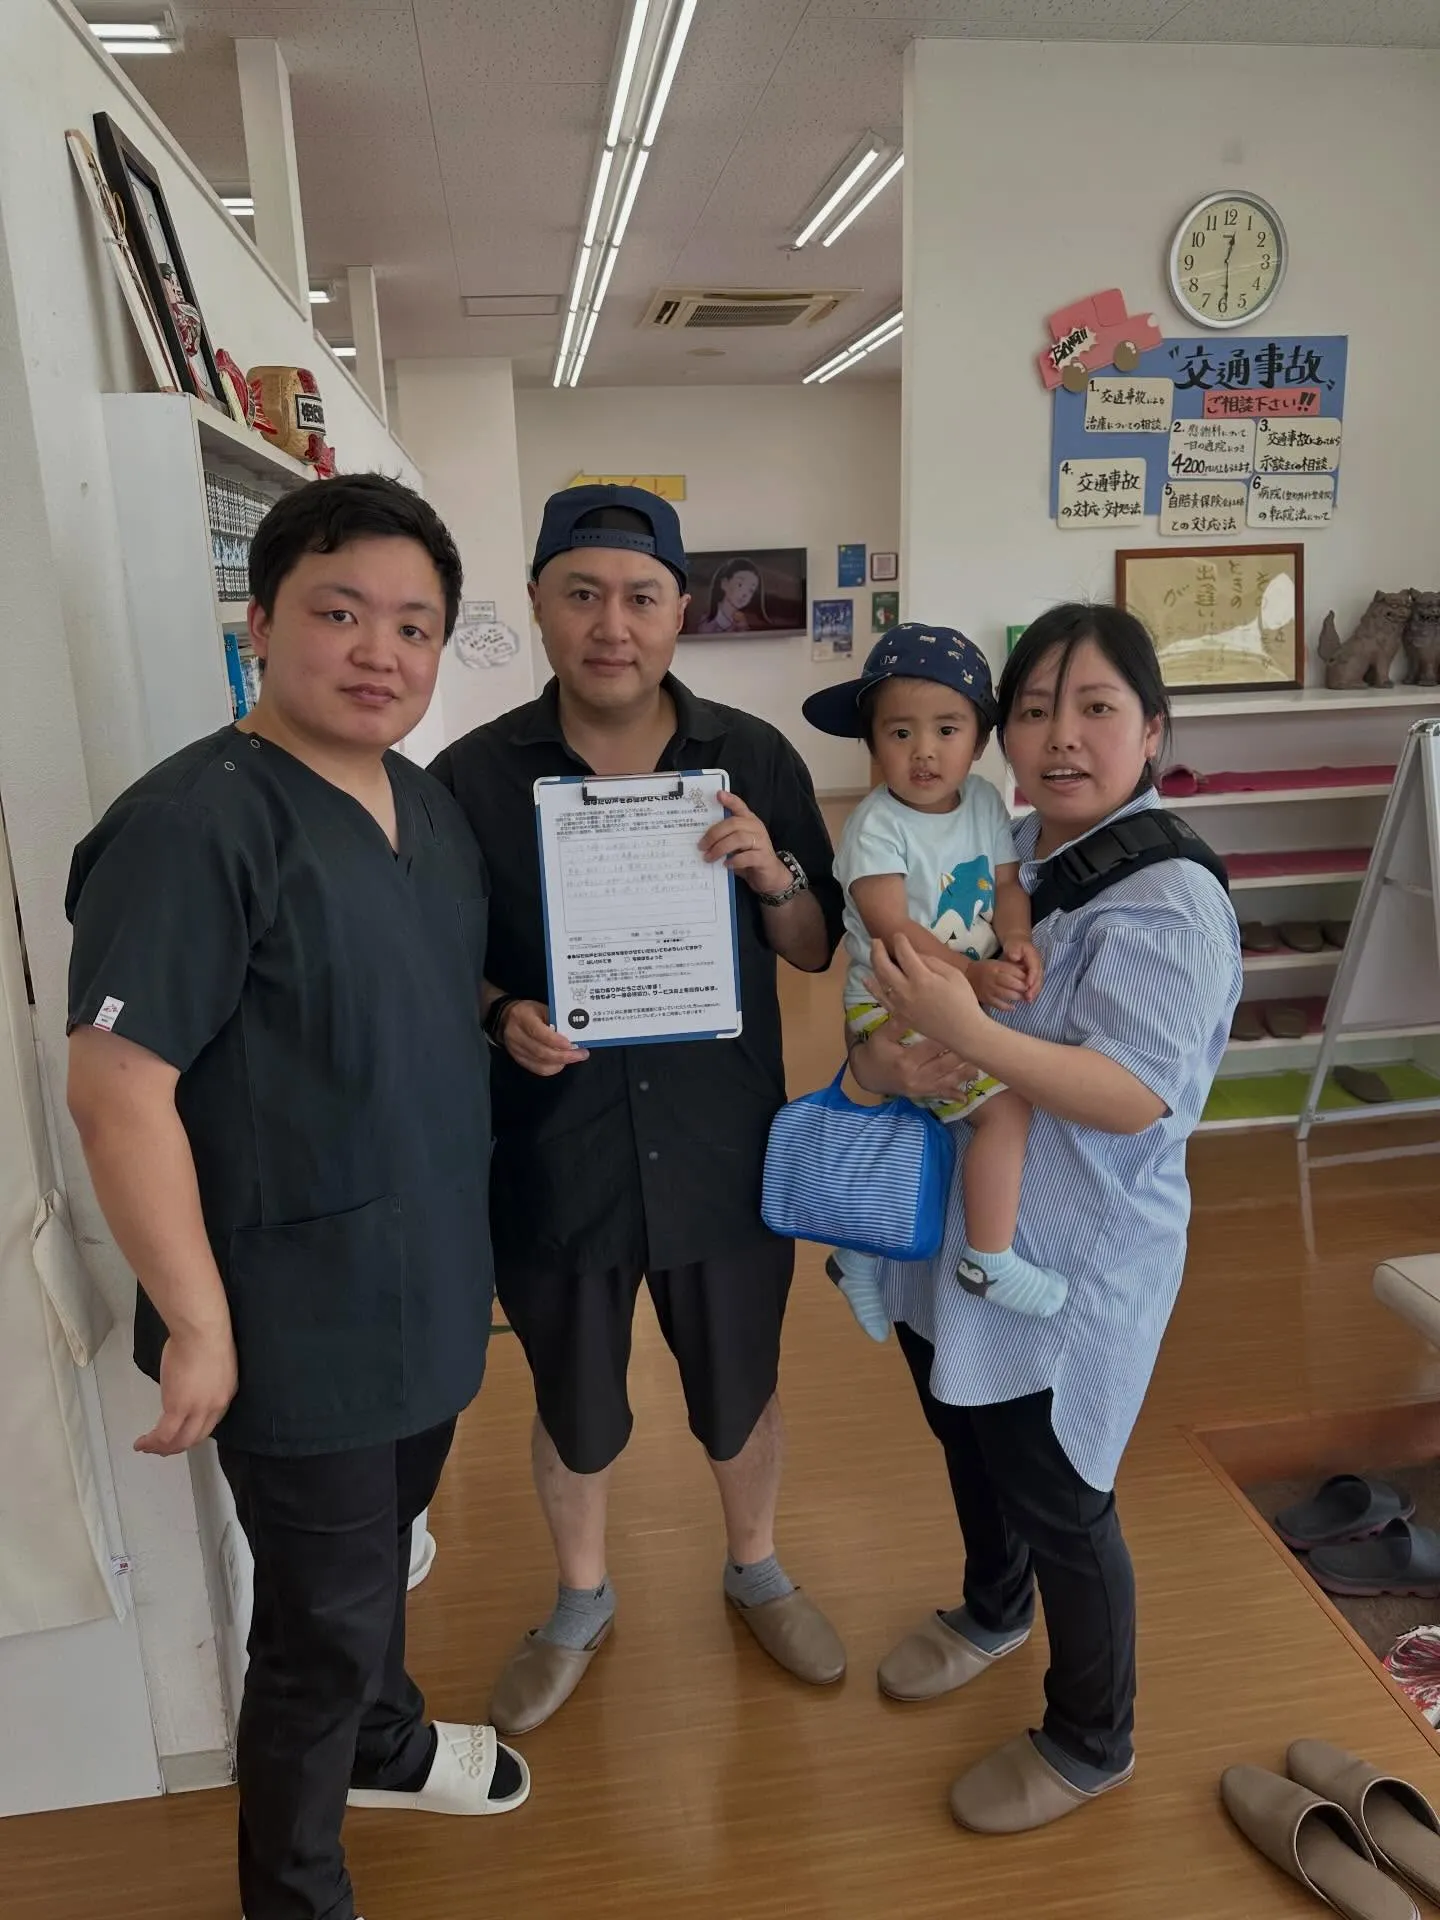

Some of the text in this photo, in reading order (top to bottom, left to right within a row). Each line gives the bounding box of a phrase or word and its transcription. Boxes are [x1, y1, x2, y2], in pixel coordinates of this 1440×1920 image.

[1206, 215, 1217, 231] 11
[1224, 208, 1238, 226] 12
[1247, 215, 1252, 231] 1
[1191, 231, 1205, 248] 10
[1257, 232, 1266, 248] 2
[1184, 254, 1194, 271] 9
[1260, 254, 1271, 270] 3
[1188, 277, 1199, 293] 8
[1252, 276, 1262, 291] 4
[1202, 292, 1211, 308] 7
[1218, 296, 1228, 313] 6
[1237, 293, 1247, 309] 5
[1100, 388, 1165, 405] 交通事故による
[1077, 469, 1141, 492] 交通事故
[1171, 517, 1237, 532] との対応法
